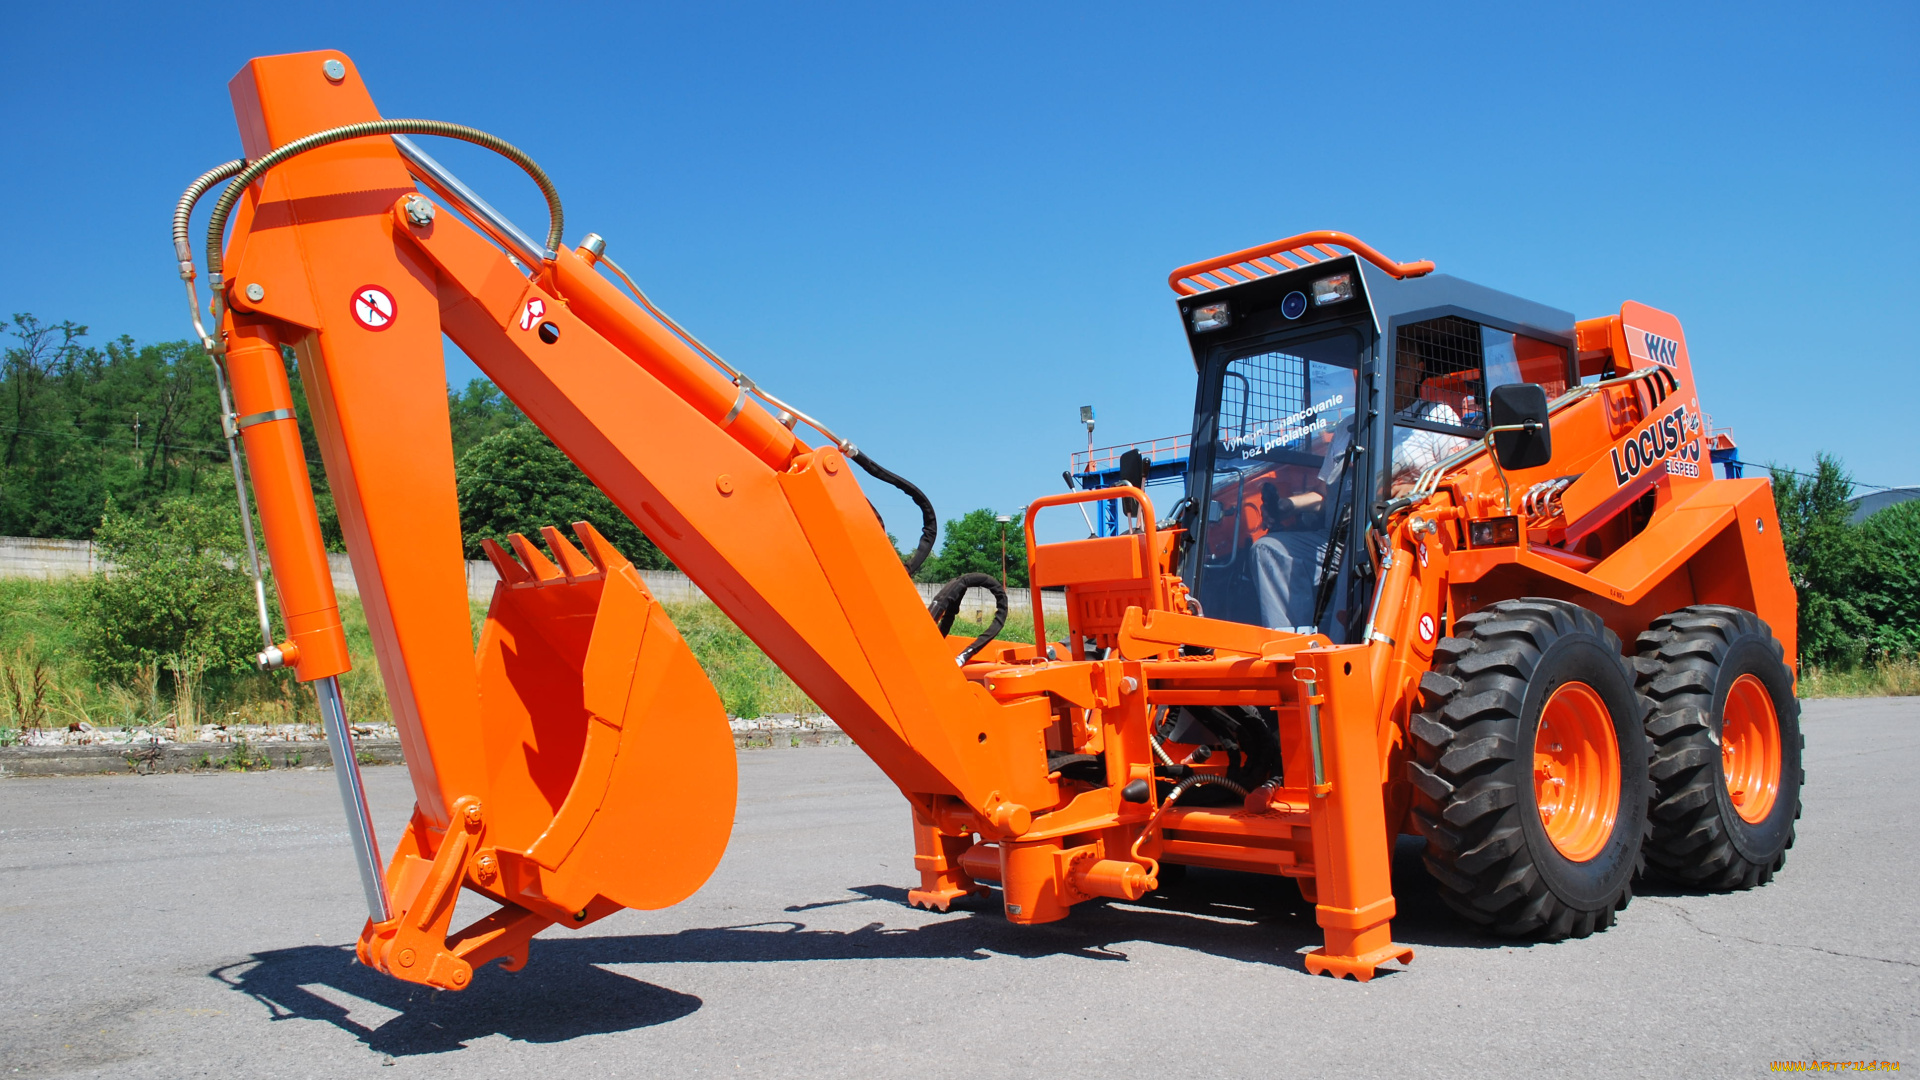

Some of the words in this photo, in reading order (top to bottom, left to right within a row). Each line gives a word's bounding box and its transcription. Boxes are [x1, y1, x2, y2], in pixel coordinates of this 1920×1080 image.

[1644, 331, 1678, 368] WAY
[1241, 445, 1262, 460] bez
[1264, 417, 1327, 454] preplatenia
[1609, 403, 1687, 488] LOCUST
